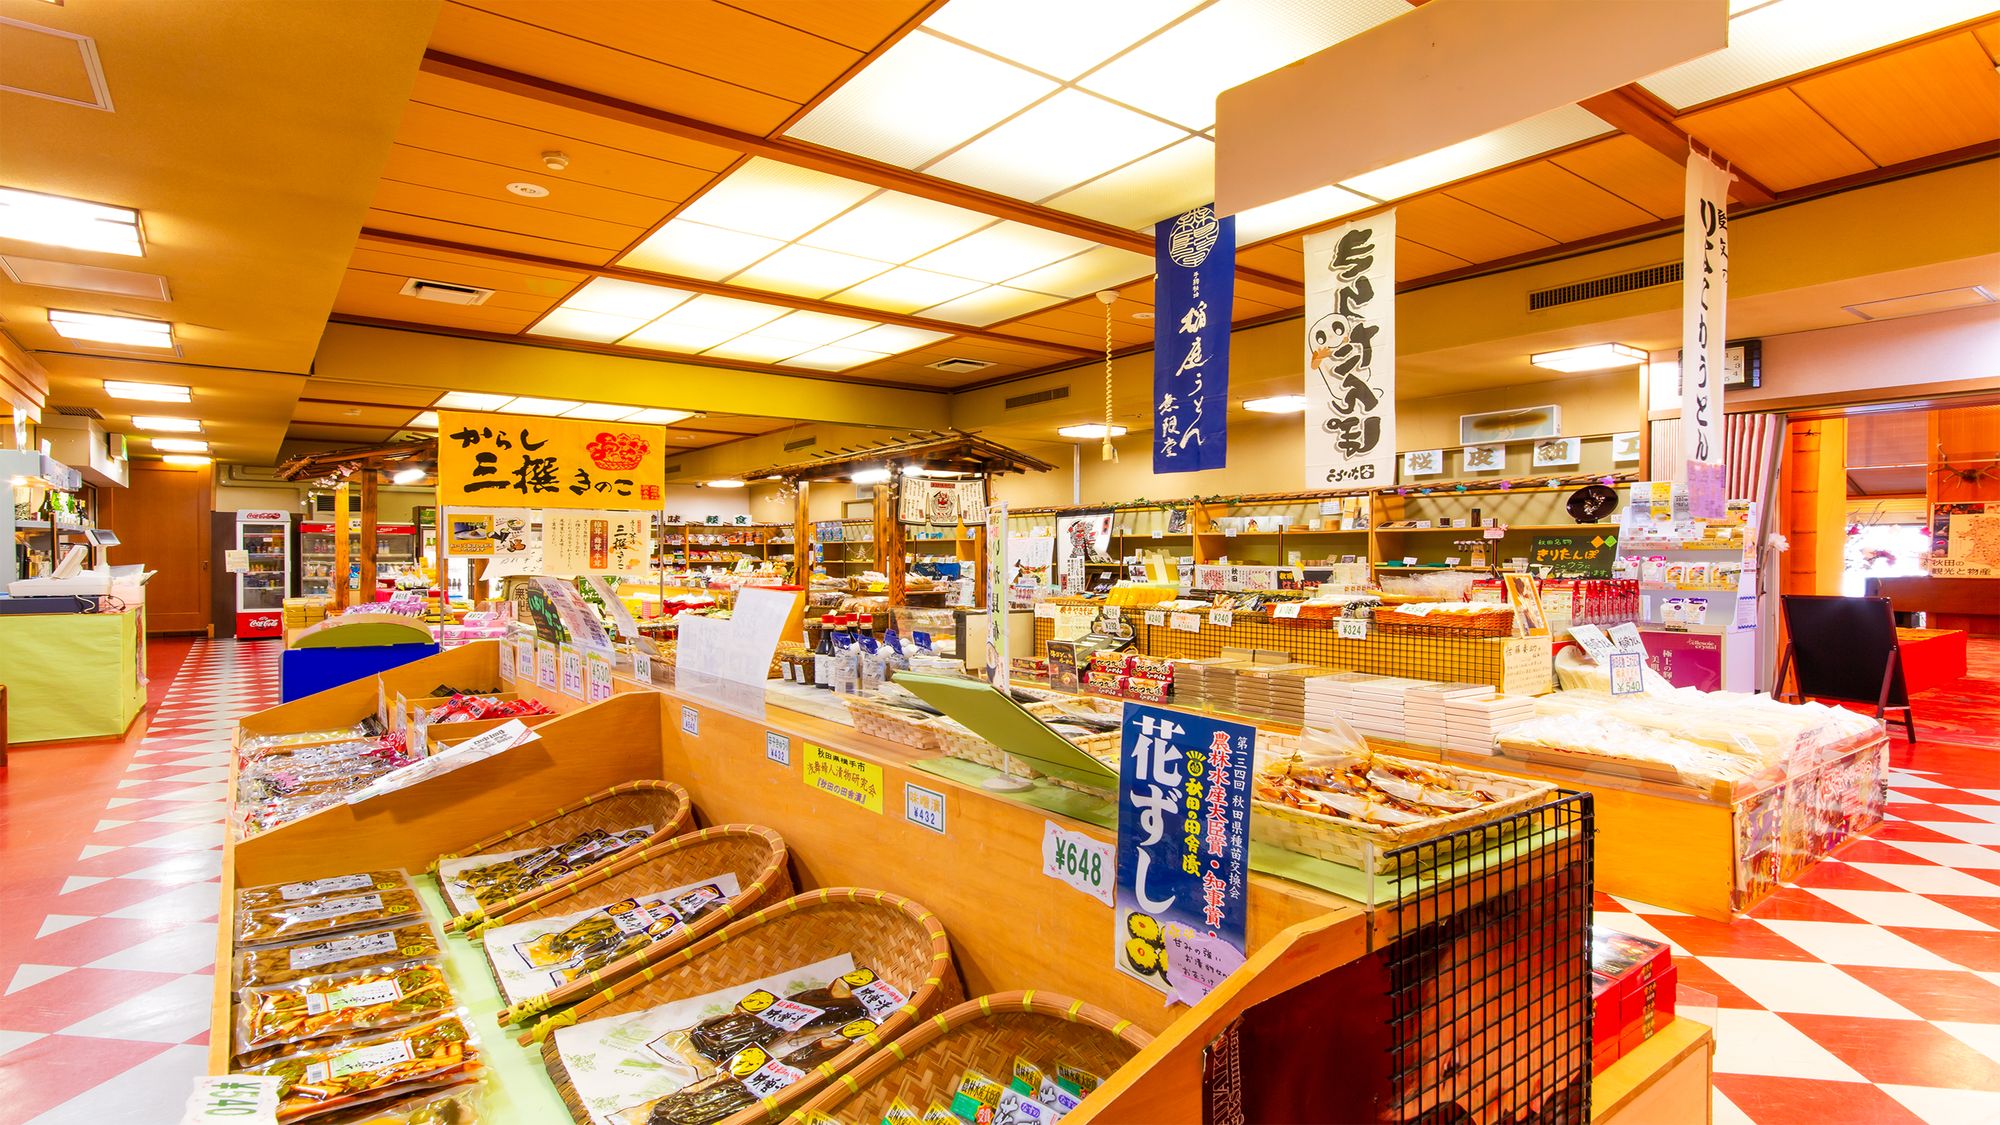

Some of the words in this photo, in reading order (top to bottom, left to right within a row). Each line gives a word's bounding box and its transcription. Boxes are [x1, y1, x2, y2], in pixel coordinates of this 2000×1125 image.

[450, 427, 548, 451] からし
[1536, 548, 1600, 561] きりたんぽ
[1213, 613, 1229, 623] ¥240
[1343, 624, 1362, 636] ¥324
[565, 672, 580, 689] 甘口
[592, 680, 610, 701] 甘口
[1617, 681, 1641, 692] ¥540
[771, 748, 785, 761] ¥432
[817, 748, 866, 772] 秋田県横手市
[1234, 736, 1248, 791] 第一三四回
[914, 806, 935, 825] ¥432
[1130, 715, 1186, 914] 花ずし
[1182, 777, 1204, 878] 秋田の田舎漬
[1228, 795, 1246, 900] 秋田県種苗交換会
[1055, 836, 1102, 887] ¥648
